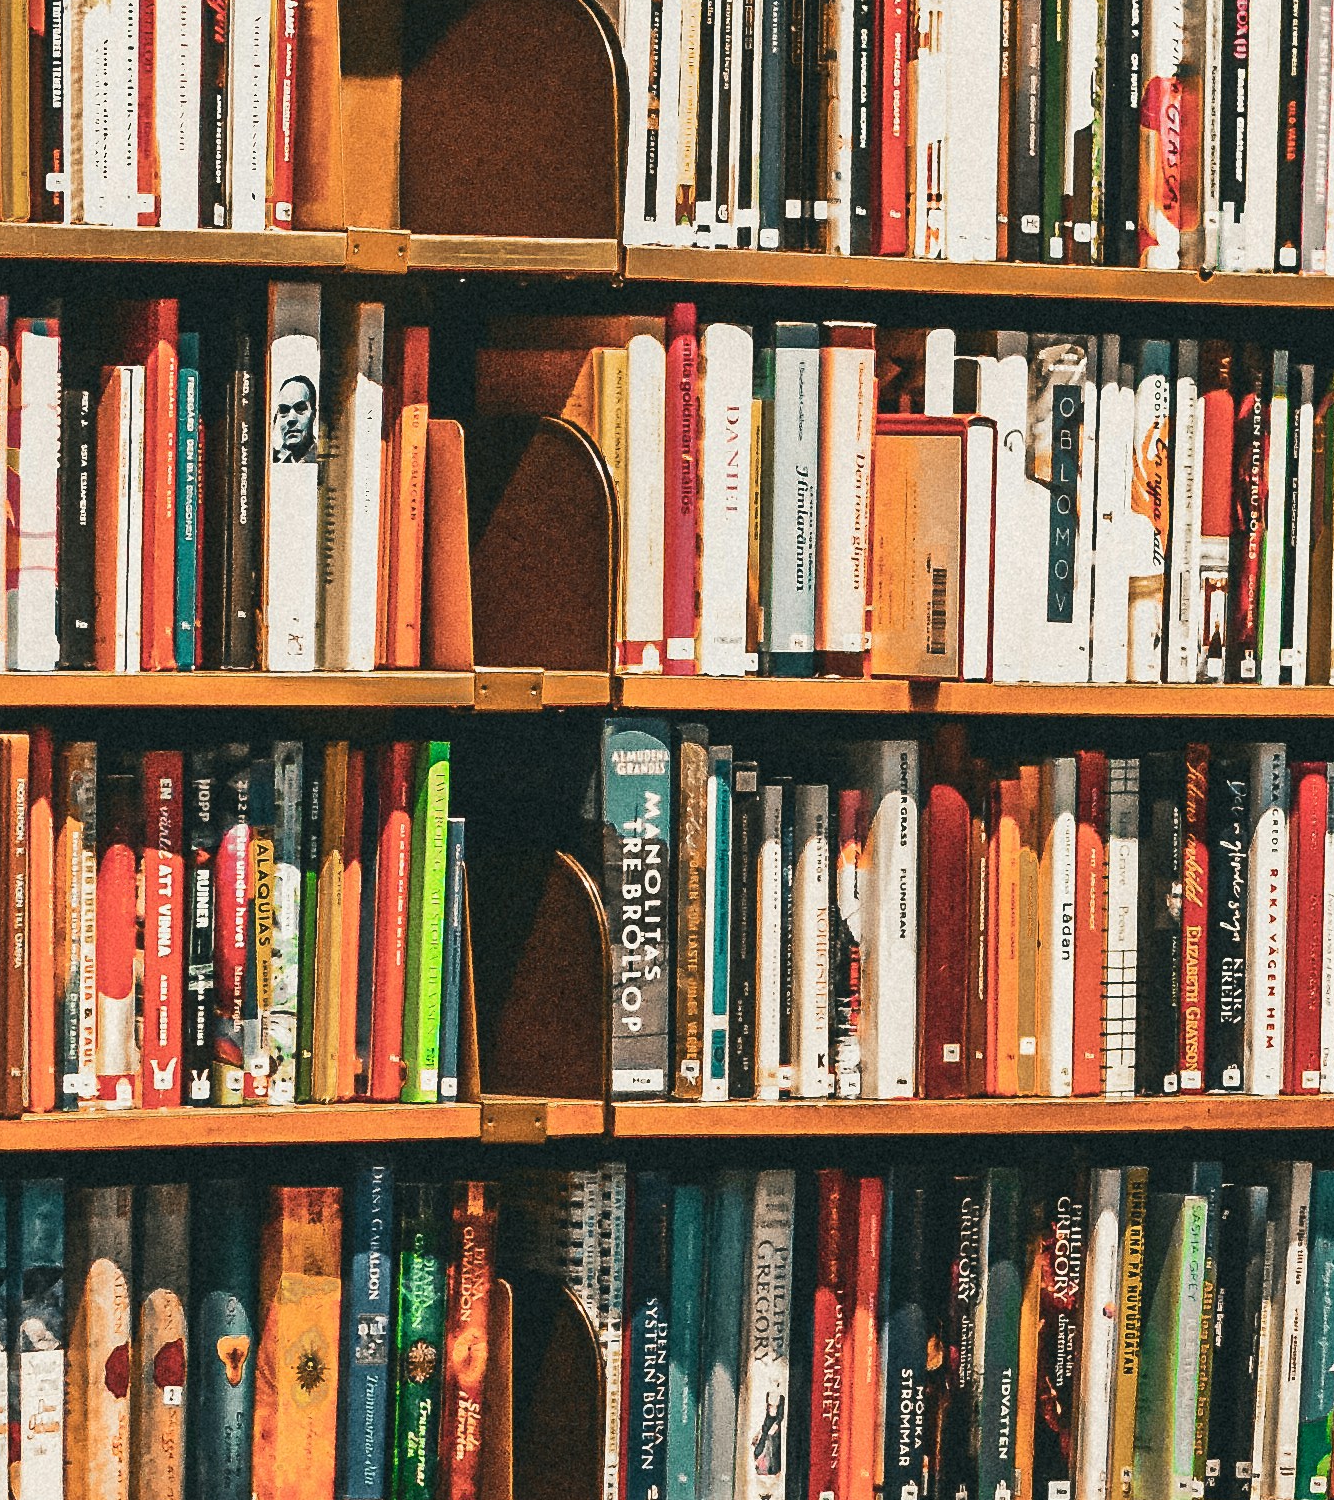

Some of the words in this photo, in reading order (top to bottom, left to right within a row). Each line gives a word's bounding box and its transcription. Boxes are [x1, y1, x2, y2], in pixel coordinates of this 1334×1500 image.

[726, 405, 739, 521] DANIEL
[855, 454, 865, 482] Den
[1156, 438, 1166, 469] En
[1251, 442, 1260, 505] HUSTRU
[853, 487, 863, 531] rosa
[1055, 397, 1073, 612] OBLOMOV
[1147, 475, 1165, 519] nypa
[852, 537, 863, 591] glipan
[1152, 526, 1164, 566] salt
[160, 778, 172, 799] EN
[623, 818, 642, 871] TRE
[158, 865, 172, 897] ATT
[196, 869, 209, 928] RUINER
[235, 861, 246, 902] under
[645, 791, 661, 981] MANOLITAS
[899, 868, 908, 939] FLUNDRAN
[1269, 868, 1278, 924] RAKA
[158, 904, 173, 956] VINNA
[234, 906, 246, 947] havet
[621, 884, 644, 1032] BRÖLLOP
[1061, 903, 1072, 961] Lådan
[1185, 925, 1200, 1002] ELIZABETH
[1220, 958, 1232, 1023] GREDE
[1233, 958, 1243, 1023] KLARA
[1267, 933, 1279, 997] VÄGEN
[84, 1026, 93, 1067] PAUL
[1185, 1007, 1199, 1071] GRAYSON
[1266, 1008, 1275, 1048] HEM
[373, 1166, 384, 1213] DIANA
[369, 1219, 382, 1300] GABALDON
[958, 1197, 969, 1303] GREGORY
[1053, 1197, 1071, 1303] GREGORY
[1069, 1204, 1082, 1295] PHILIPPA
[1192, 1205, 1202, 1254] SASHA
[754, 1240, 772, 1366] GREGORY
[773, 1245, 788, 1363] PHILIPPA
[1188, 1260, 1198, 1302] GREY
[644, 1297, 658, 1383] SYSTERN
[366, 1375, 378, 1456] Trummornas
[642, 1392, 657, 1470] BOLEYN
[899, 1368, 912, 1466] STRÖMMAR
[915, 1386, 924, 1448] MÖRKA
[999, 1368, 1011, 1458] TIDVATTEN
